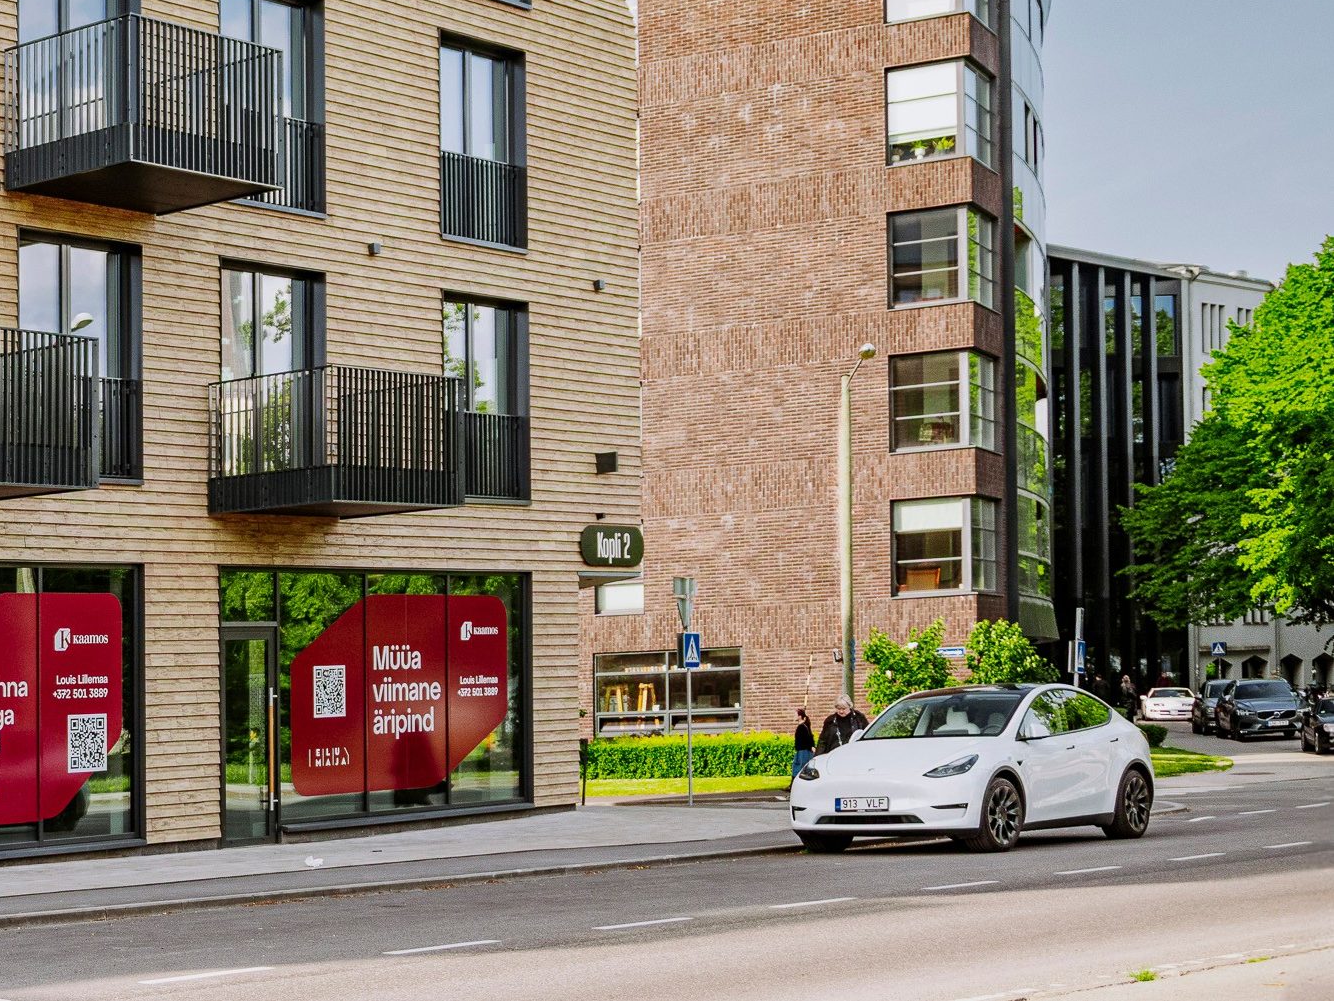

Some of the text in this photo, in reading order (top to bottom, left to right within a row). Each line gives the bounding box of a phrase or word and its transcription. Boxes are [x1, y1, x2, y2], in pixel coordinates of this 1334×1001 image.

[596, 531, 631, 564] Kopli 2
[373, 644, 421, 670] Müüa
[56, 673, 109, 685] Louis Lillemaa
[459, 675, 475, 684] Louis
[52, 687, 109, 699] +372 501 3889
[372, 676, 442, 702] viimane
[472, 687, 483, 697] 501
[373, 706, 435, 740] äripind
[842, 798, 885, 808] 913 VLF
